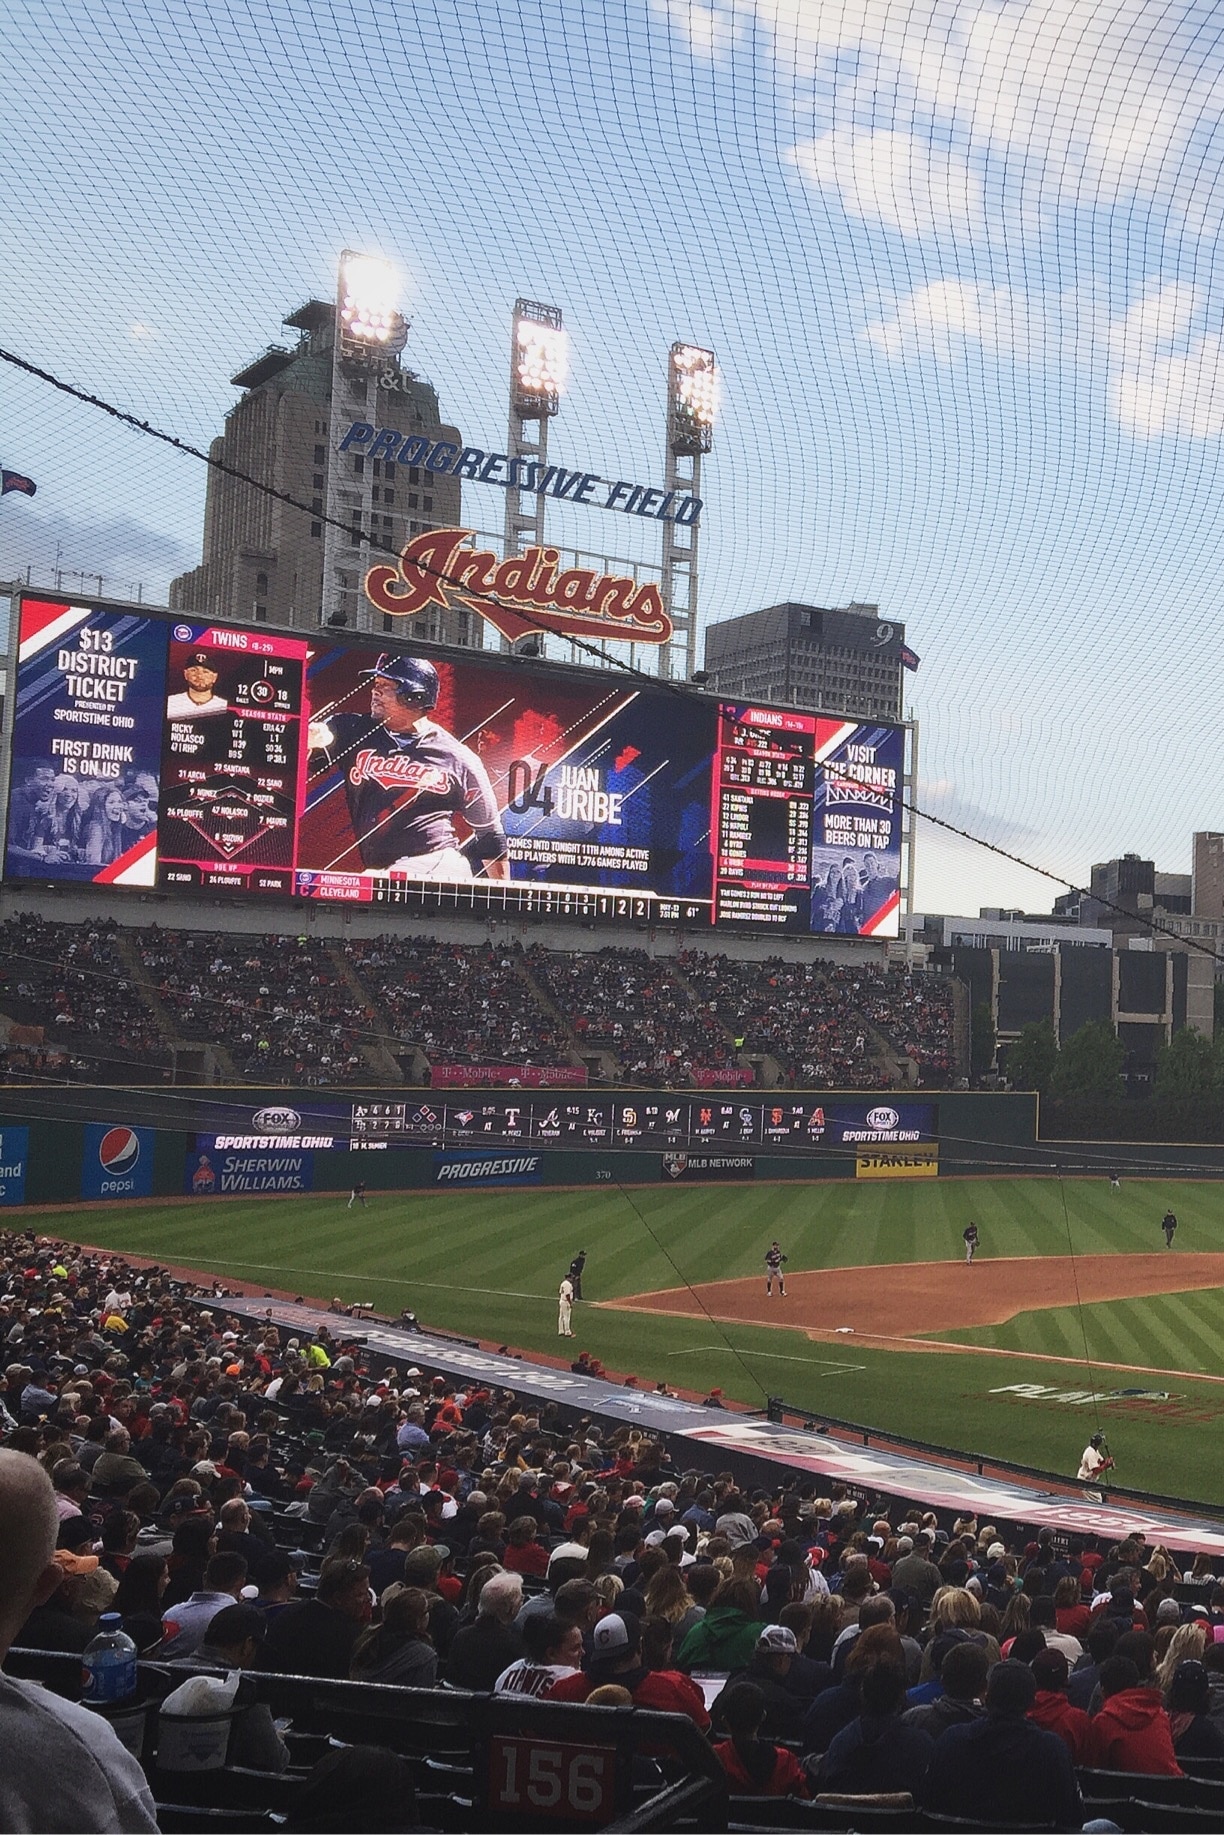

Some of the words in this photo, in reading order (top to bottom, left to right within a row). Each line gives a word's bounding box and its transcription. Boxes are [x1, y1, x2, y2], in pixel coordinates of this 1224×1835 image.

[339, 422, 600, 504] PROGRESSIVE
[605, 481, 703, 526] FIELD
[365, 529, 673, 643] Indians
[80, 627, 113, 652] $13
[212, 631, 248, 648] TWINS
[57, 650, 138, 679] DISTRICT
[268, 665, 283, 675] MPH
[66, 674, 127, 702] TICKET
[238, 684, 248, 695] 12
[256, 686, 268, 697] 30
[277, 690, 288, 701] 18
[75, 700, 106, 711] PRESENTED
[107, 704, 115, 712] BY
[54, 709, 110, 726] SPORTSTIME
[112, 716, 134, 728] OHIO
[751, 711, 783, 727] INDIANS
[171, 723, 193, 734] RICKY
[171, 733, 204, 745] NOLASCO
[52, 739, 90, 757] FIRST
[93, 744, 133, 762] DRINK
[847, 744, 876, 764] VISIT
[63, 757, 77, 773] IS
[80, 760, 98, 776] ON
[102, 762, 120, 778] US
[823, 760, 846, 781] THE
[849, 762, 896, 788] CORNER
[558, 765, 599, 791] JUAN
[508, 760, 555, 817] 04
[557, 789, 623, 825] URIBE
[824, 813, 852, 830] MORE
[853, 816, 877, 833] THAN
[879, 820, 891, 834] 30
[507, 837, 532, 849] COMES
[533, 839, 550, 851] INTO
[551, 841, 582, 854] TONIGHT
[582, 844, 600, 855] 11TH
[600, 846, 624, 858] AMONG
[626, 848, 650, 860] ACTIVE
[825, 829, 856, 847] BEERS
[857, 834, 871, 848] ON
[872, 834, 890, 850] TAP
[507, 849, 523, 860] MLB
[524, 850, 556, 863] PLAYERS
[558, 853, 576, 865] WITH
[597, 857, 621, 869] GAMES
[622, 860, 648, 872] PLAYED
[320, 876, 360, 887] MINNESOTA
[320, 887, 359, 898] CLEVELAND
[263, 1113, 290, 1124] FOX
[874, 1112, 891, 1121] FOX
[214, 1135, 301, 1150] SPORTSTIME
[301, 1136, 332, 1149] OHIO
[842, 1130, 898, 1142] SPORTSTIME
[899, 1130, 920, 1141] OHIO
[223, 1156, 302, 1173] SHERWIN
[437, 1157, 539, 1180] PROGRESSIVE
[688, 1159, 707, 1169] MLB
[709, 1158, 752, 1168] NETWORK
[861, 1153, 934, 1168] STANLEY
[595, 1171, 611, 1180] 370
[101, 1177, 135, 1194] pepsi
[1035, 1508, 1163, 1531] 1954
[600, 1629, 610, 1644] C
[500, 1745, 604, 1812] 156
